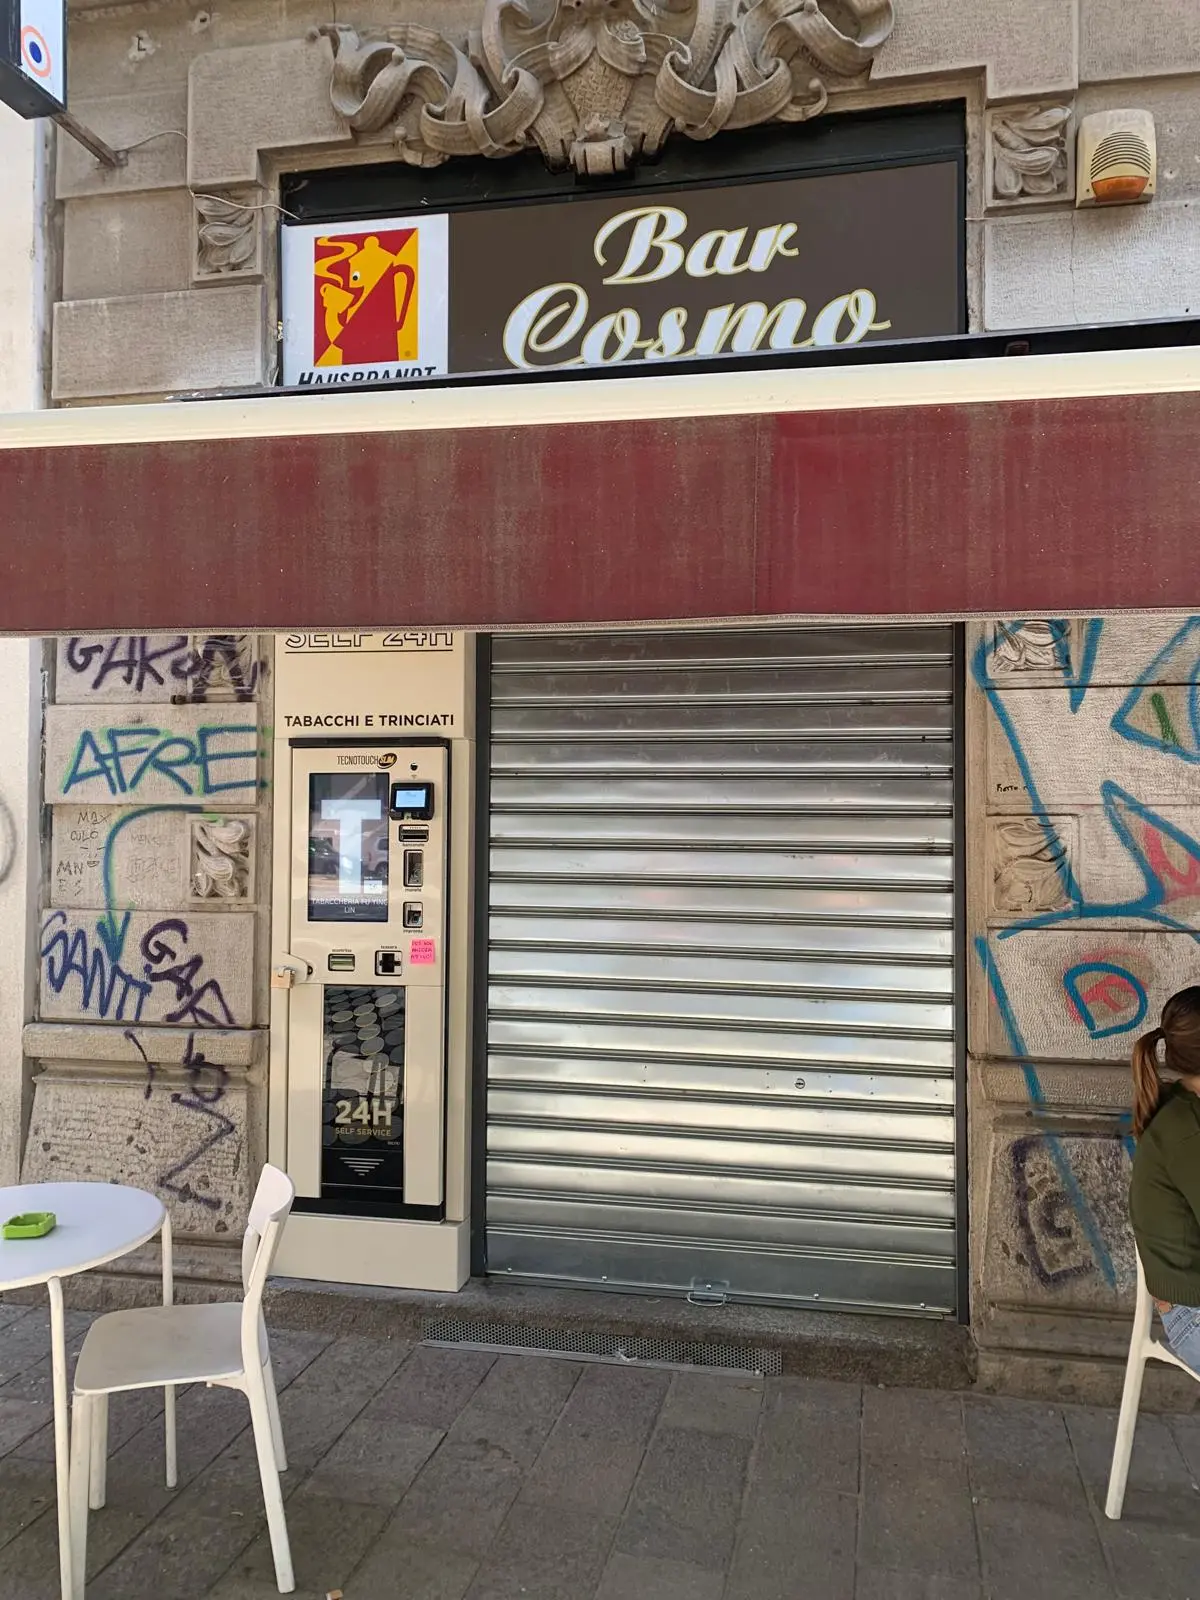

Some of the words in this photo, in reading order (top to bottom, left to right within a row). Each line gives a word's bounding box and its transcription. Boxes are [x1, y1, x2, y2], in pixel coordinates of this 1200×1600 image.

[594, 206, 800, 285] Bar
[503, 282, 892, 370] Cosmo
[284, 714, 359, 727] TABACCHI
[364, 714, 374, 726] E
[378, 713, 454, 726] TRINCIATI
[336, 755, 379, 765] TECNOTOUCH
[335, 1097, 393, 1127] 24H
[335, 1127, 355, 1135] SELF
[356, 1128, 392, 1137] SERVICE
